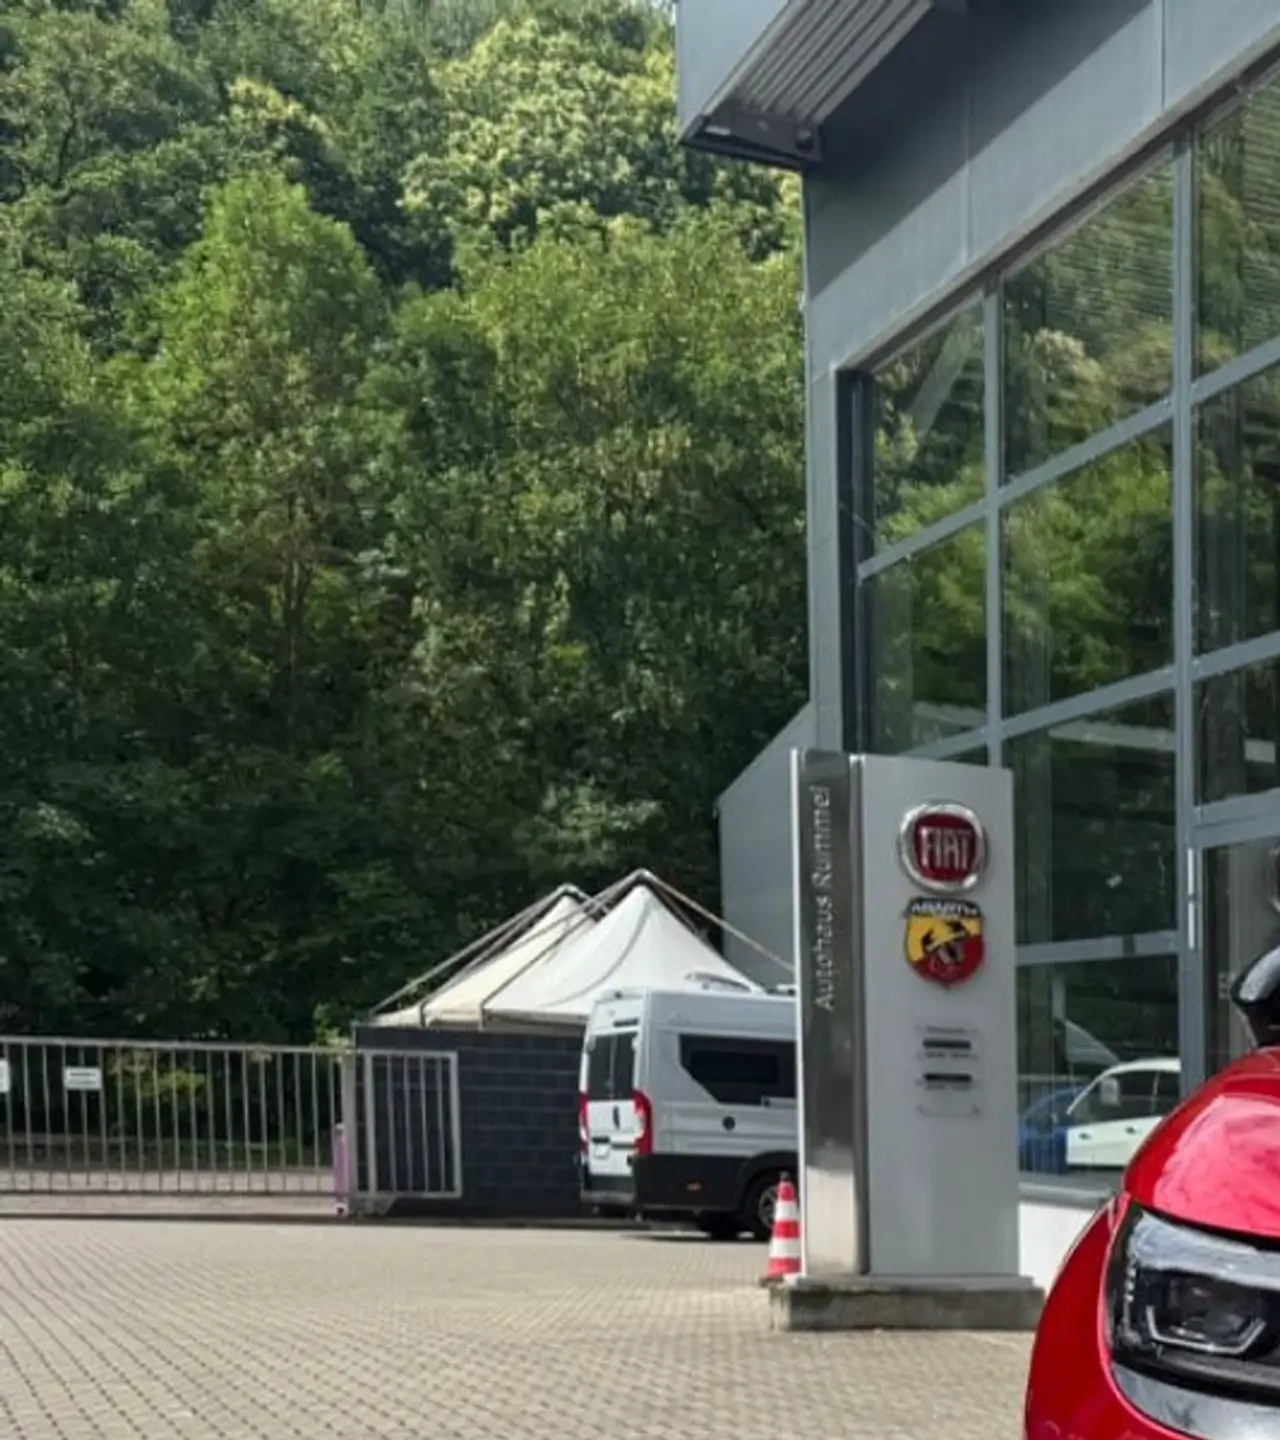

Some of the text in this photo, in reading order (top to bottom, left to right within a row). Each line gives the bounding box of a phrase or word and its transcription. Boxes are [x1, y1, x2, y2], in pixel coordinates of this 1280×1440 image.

[809, 785, 835, 1012] Autohaus Rummel
[920, 826, 973, 870] FIAT
